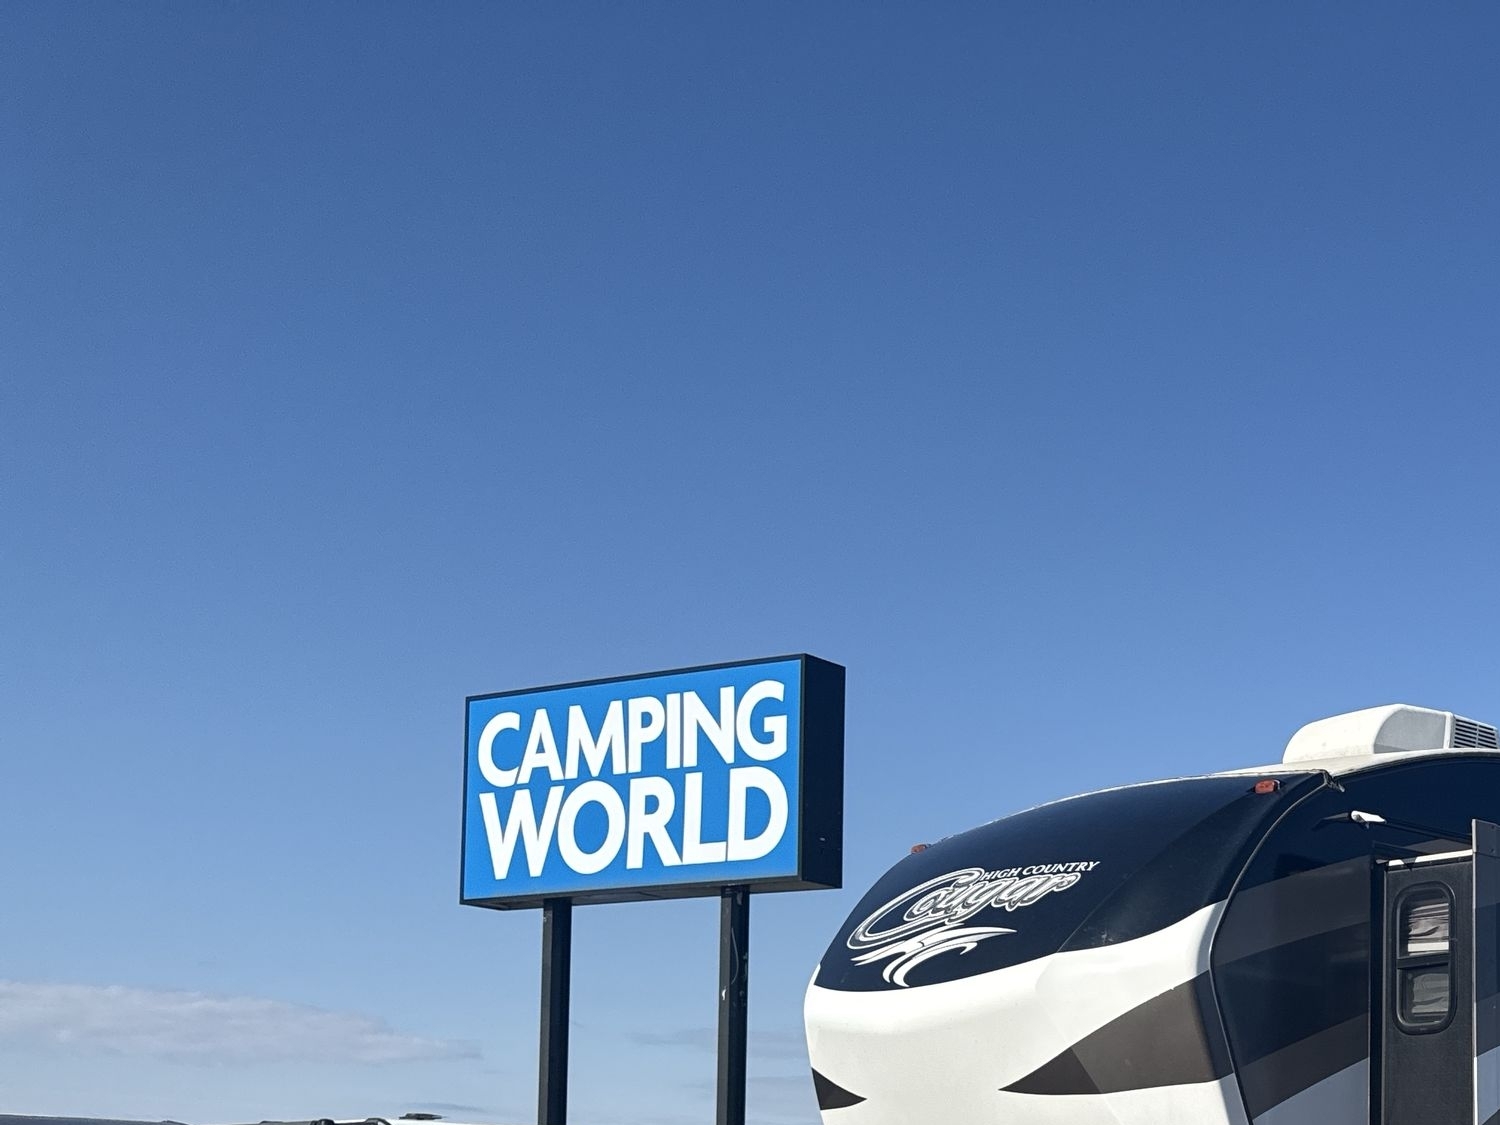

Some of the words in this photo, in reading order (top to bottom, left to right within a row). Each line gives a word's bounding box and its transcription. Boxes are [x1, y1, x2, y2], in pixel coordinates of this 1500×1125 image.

[477, 680, 788, 788] CAMPING
[479, 766, 789, 880] WORLD
[847, 868, 1081, 949] Cougar
[982, 867, 1021, 881] HIGH
[1022, 861, 1100, 876] COUNTRY
